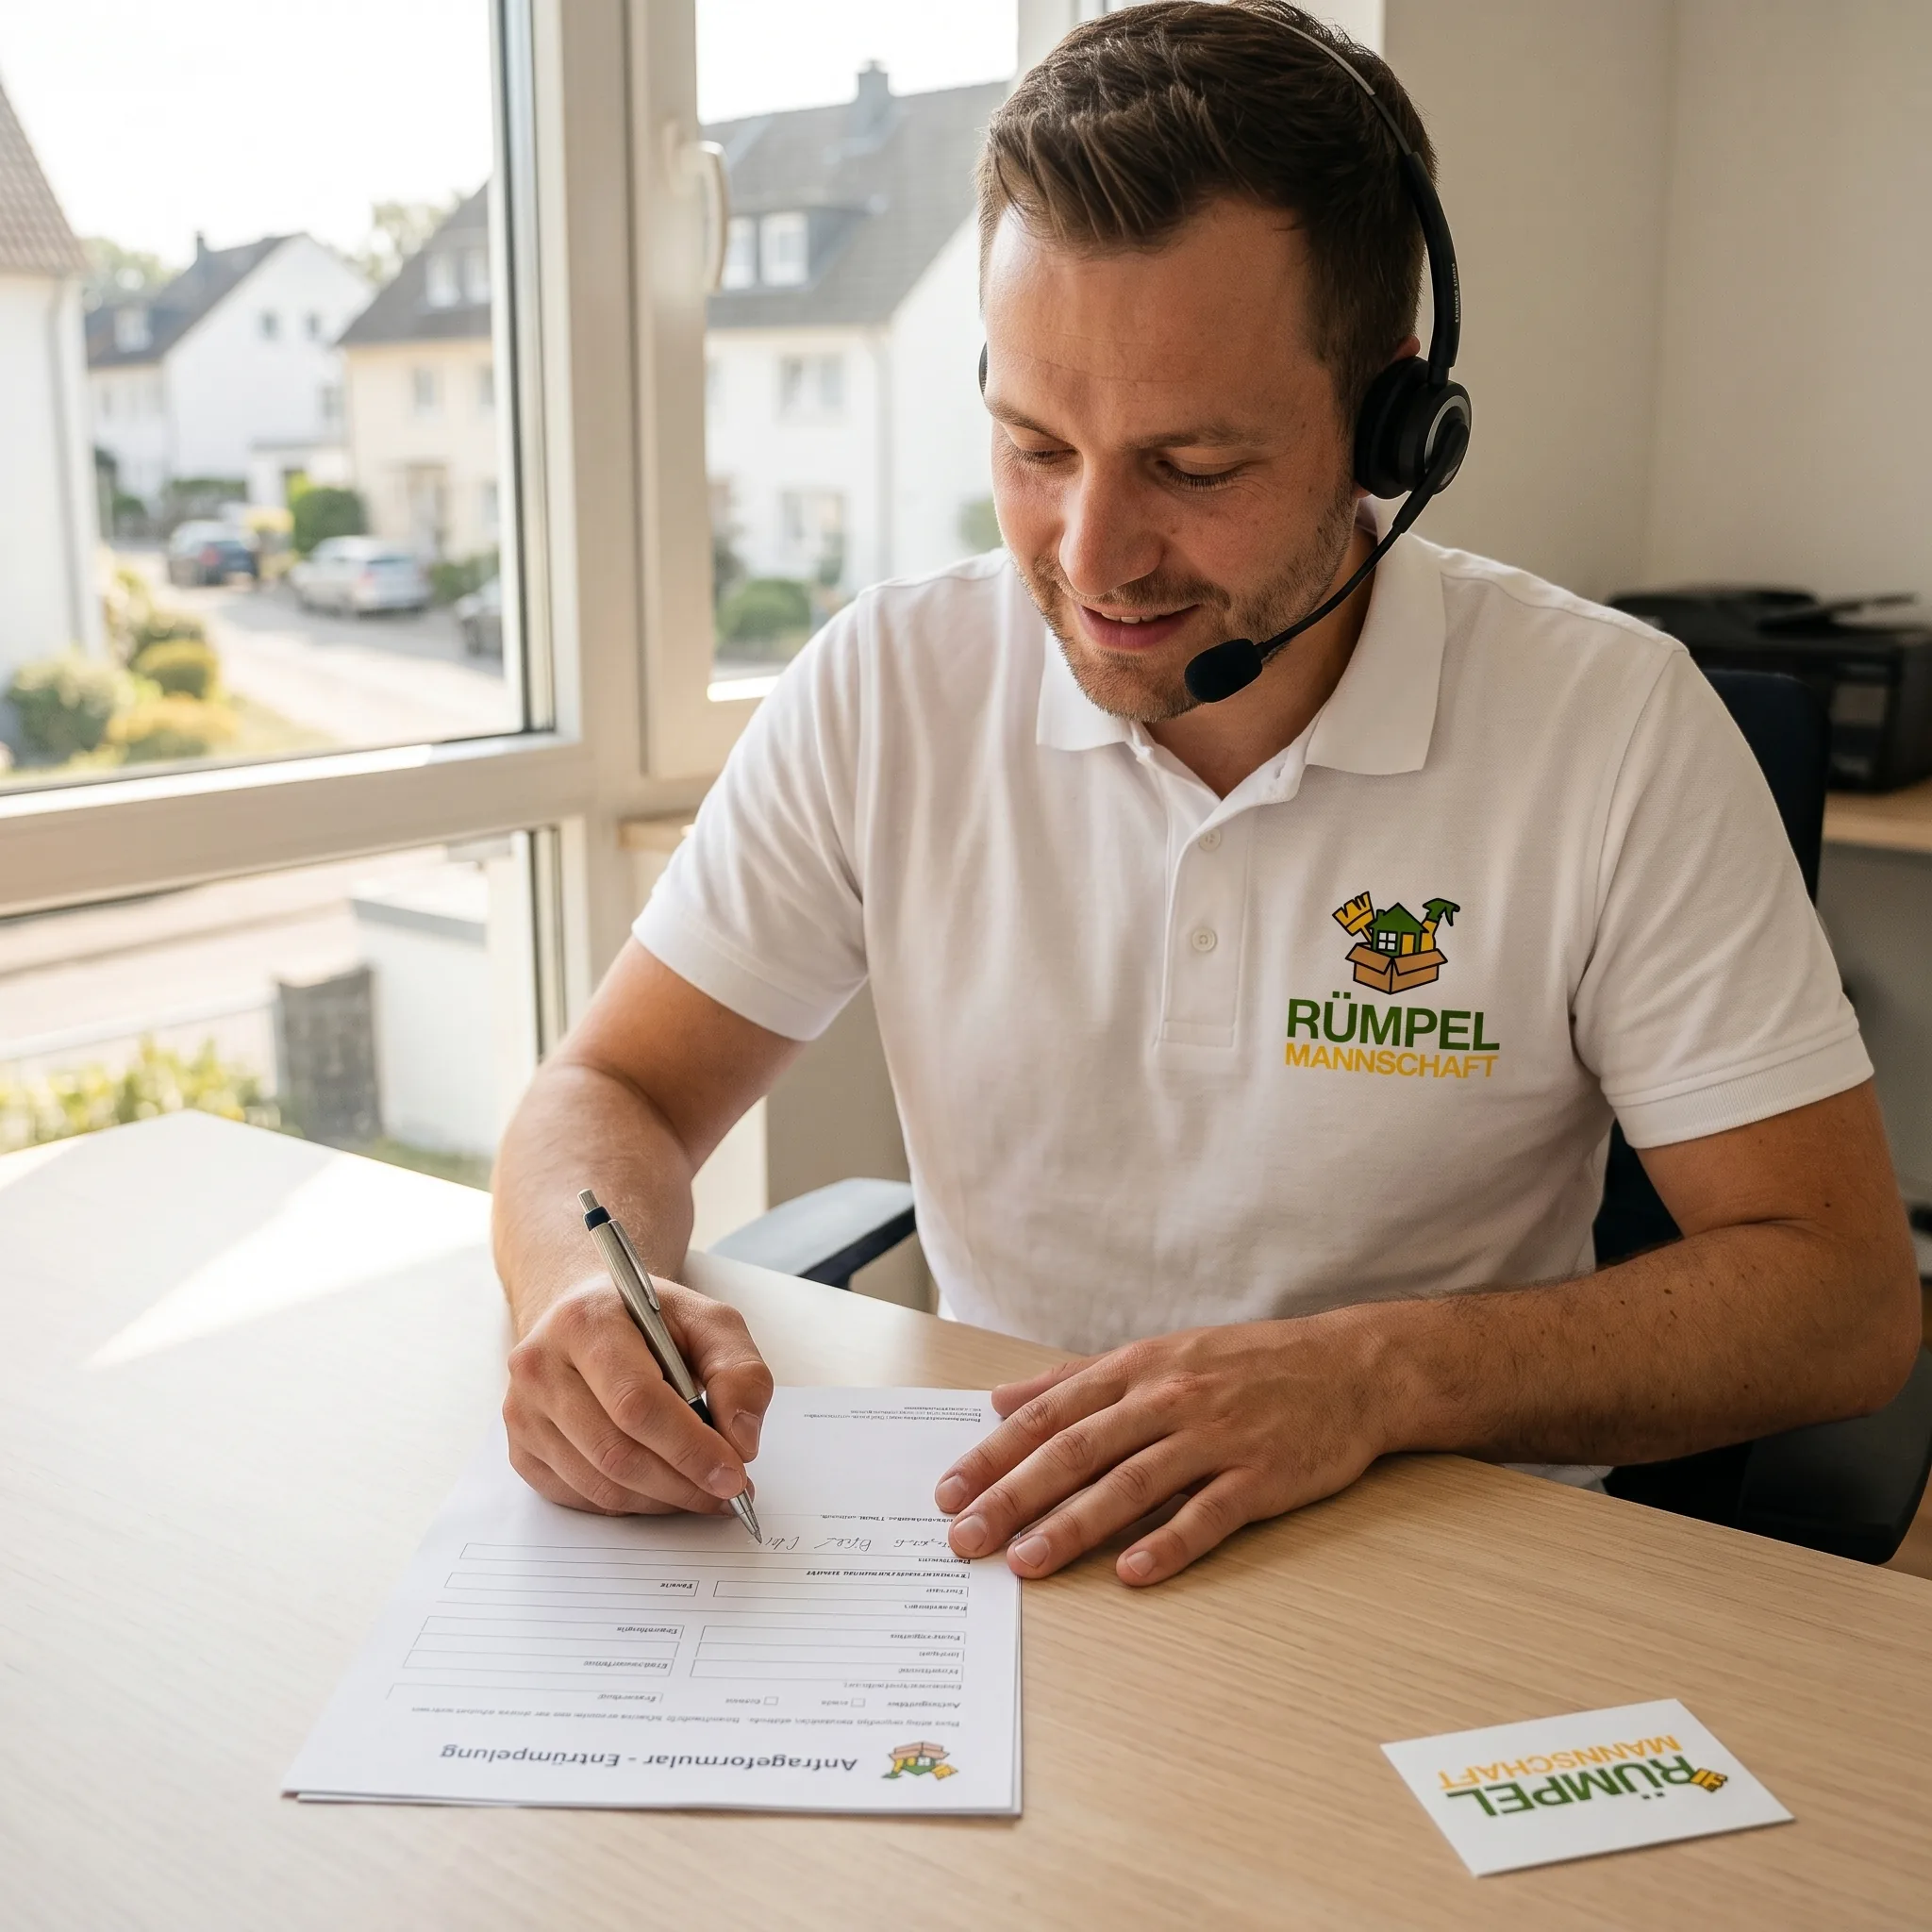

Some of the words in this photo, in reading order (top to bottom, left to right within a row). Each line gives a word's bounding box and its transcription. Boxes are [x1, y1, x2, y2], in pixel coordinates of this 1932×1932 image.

[1287, 991, 1500, 1052] RÜMPEL
[1285, 1041, 1500, 1079] MANNSCHAFT
[440, 1743, 622, 1769] Entrümpelung
[643, 1751, 858, 1773] Anfrageformular
[1439, 1735, 1683, 1789] MANNSCHAFT
[1446, 1756, 1696, 1816] RÜMPEL
